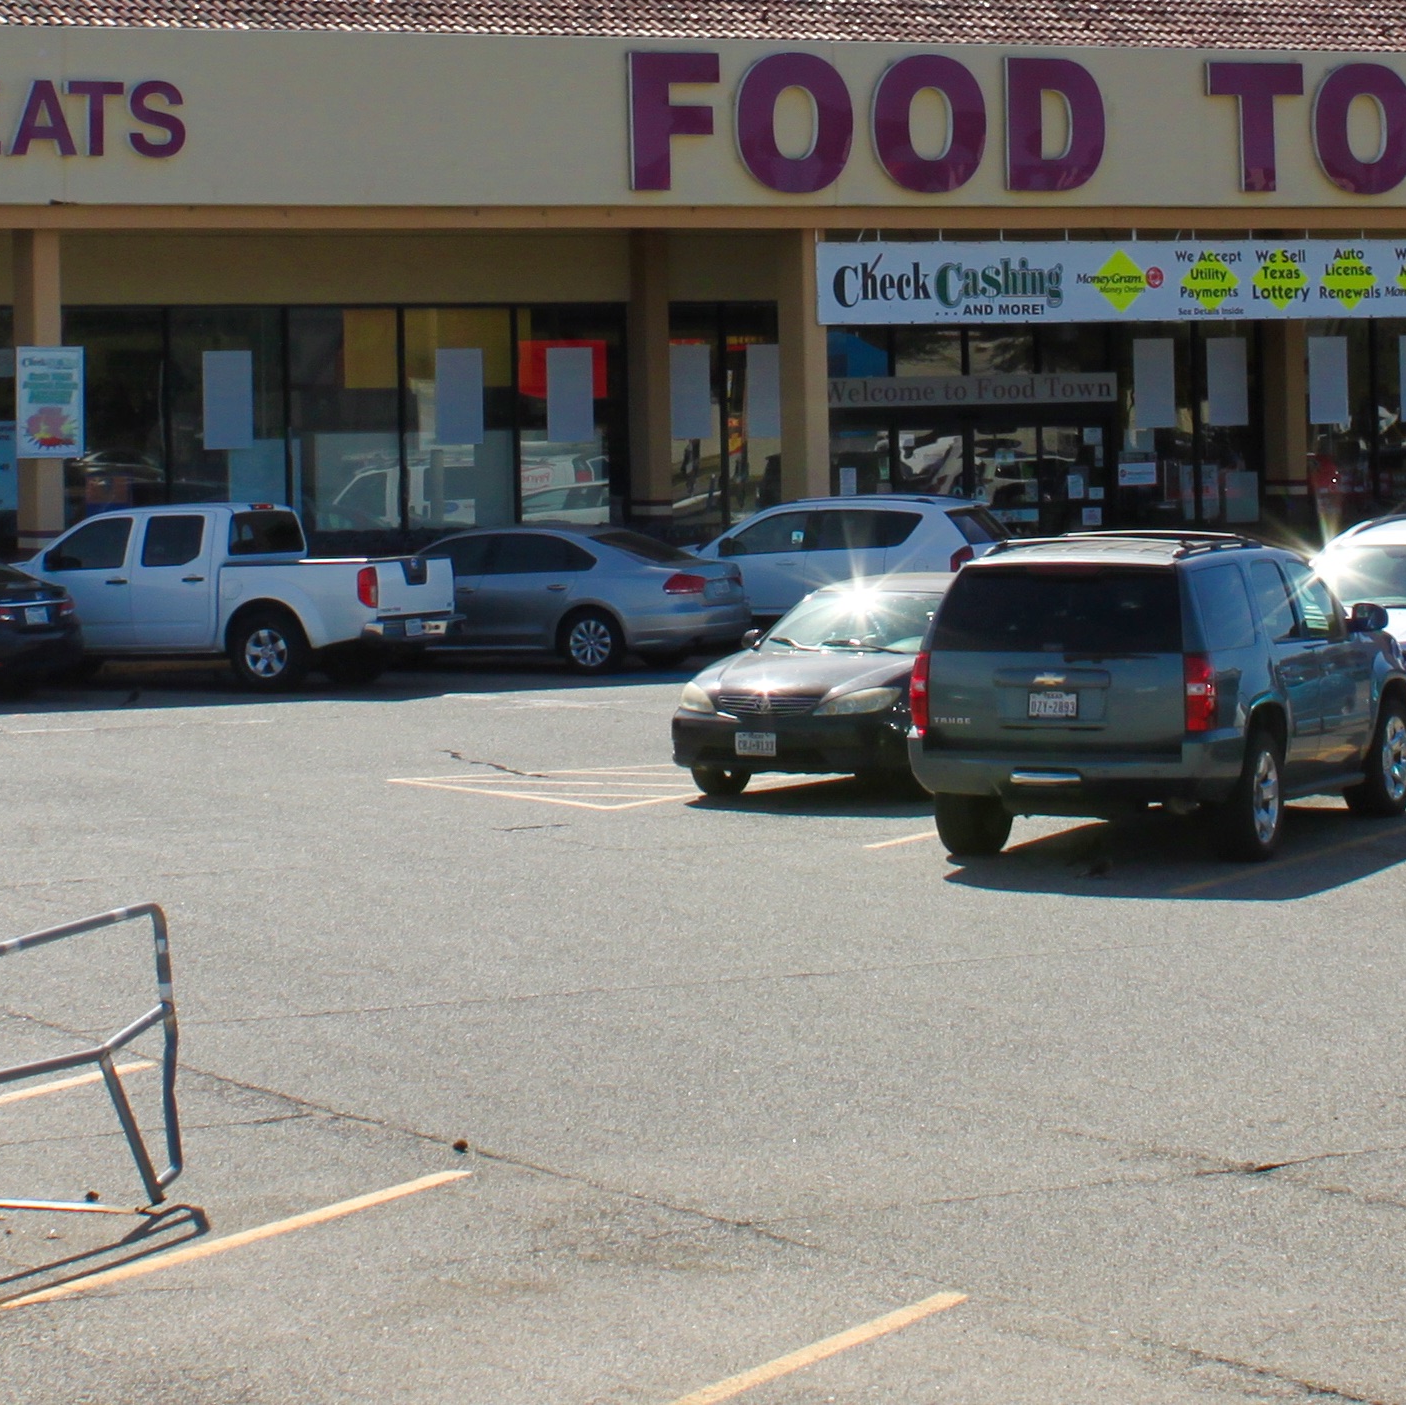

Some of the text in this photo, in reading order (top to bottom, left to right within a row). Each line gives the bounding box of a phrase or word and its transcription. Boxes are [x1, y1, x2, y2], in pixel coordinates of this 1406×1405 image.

[626, 51, 1106, 194] FOOD
[1175, 250, 1242, 265] We Accept
[1255, 249, 1306, 263] We Sell
[1333, 248, 1364, 260] Auto
[1190, 268, 1227, 282] Utility
[1262, 266, 1300, 280] Texas
[1325, 264, 1373, 276] License
[833, 253, 932, 308] Check
[1180, 286, 1238, 300] Payments
[1252, 284, 1310, 303] Lottery
[1319, 286, 1381, 299] Renewals
[963, 303, 994, 316] AND
[998, 302, 1045, 316] MORE!
[1221, 306, 1244, 314] Inside
[945, 383, 967, 400] to
[976, 378, 1038, 400] Food
[1044, 377, 1112, 397] Town
